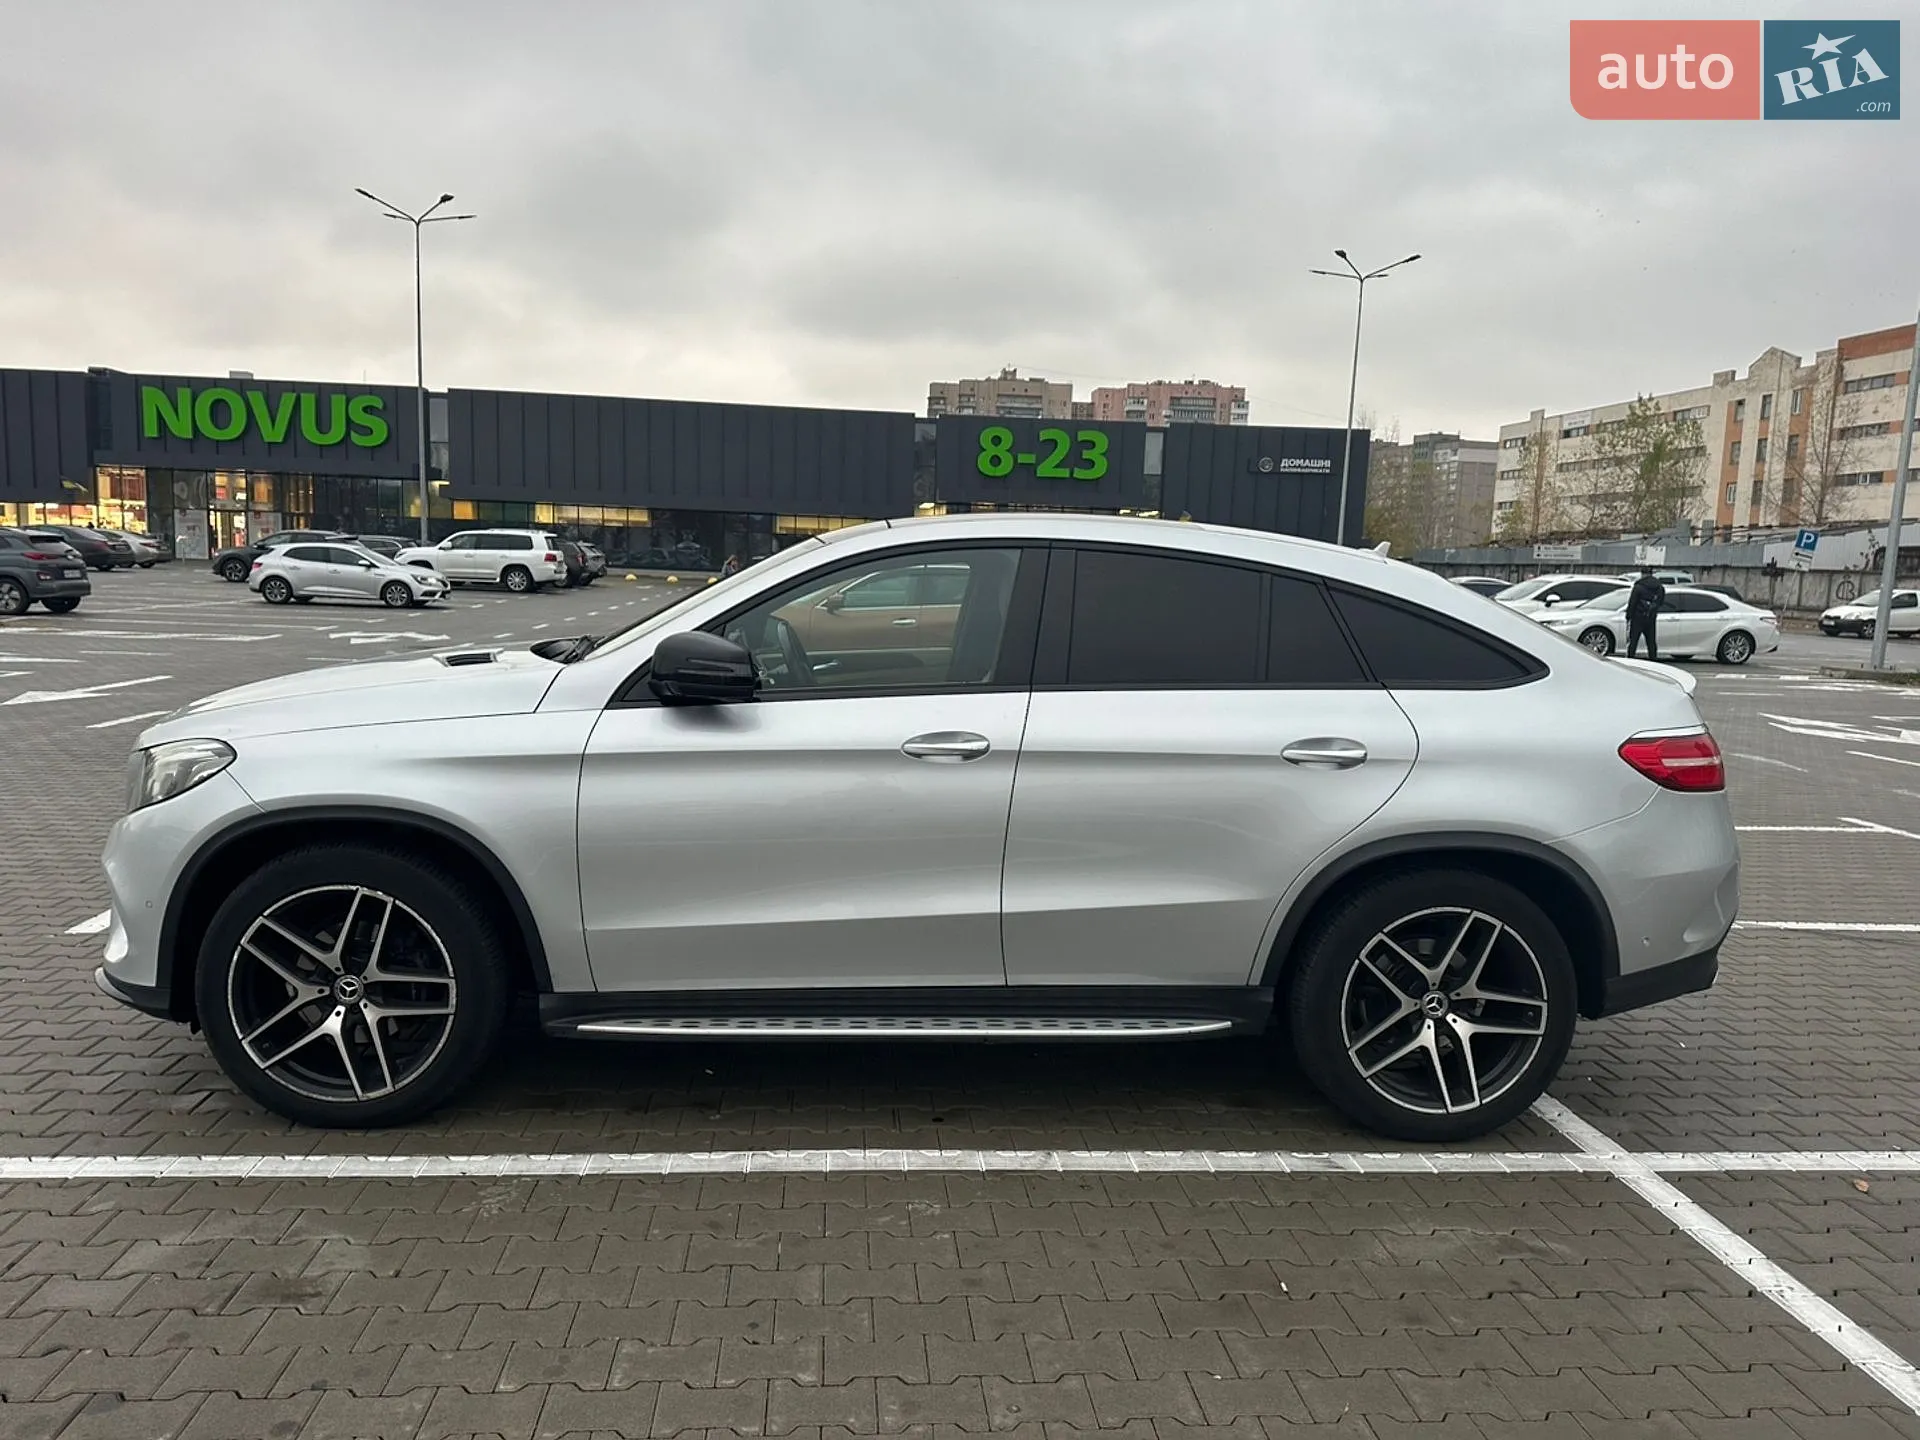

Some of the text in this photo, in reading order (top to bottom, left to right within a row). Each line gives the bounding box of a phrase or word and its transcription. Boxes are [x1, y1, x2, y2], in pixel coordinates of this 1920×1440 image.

[142, 386, 389, 447] NOVUS
[977, 426, 1109, 480] 8-23
[1280, 458, 1331, 468] ДОМАШНІ
[1801, 532, 1815, 547] P
